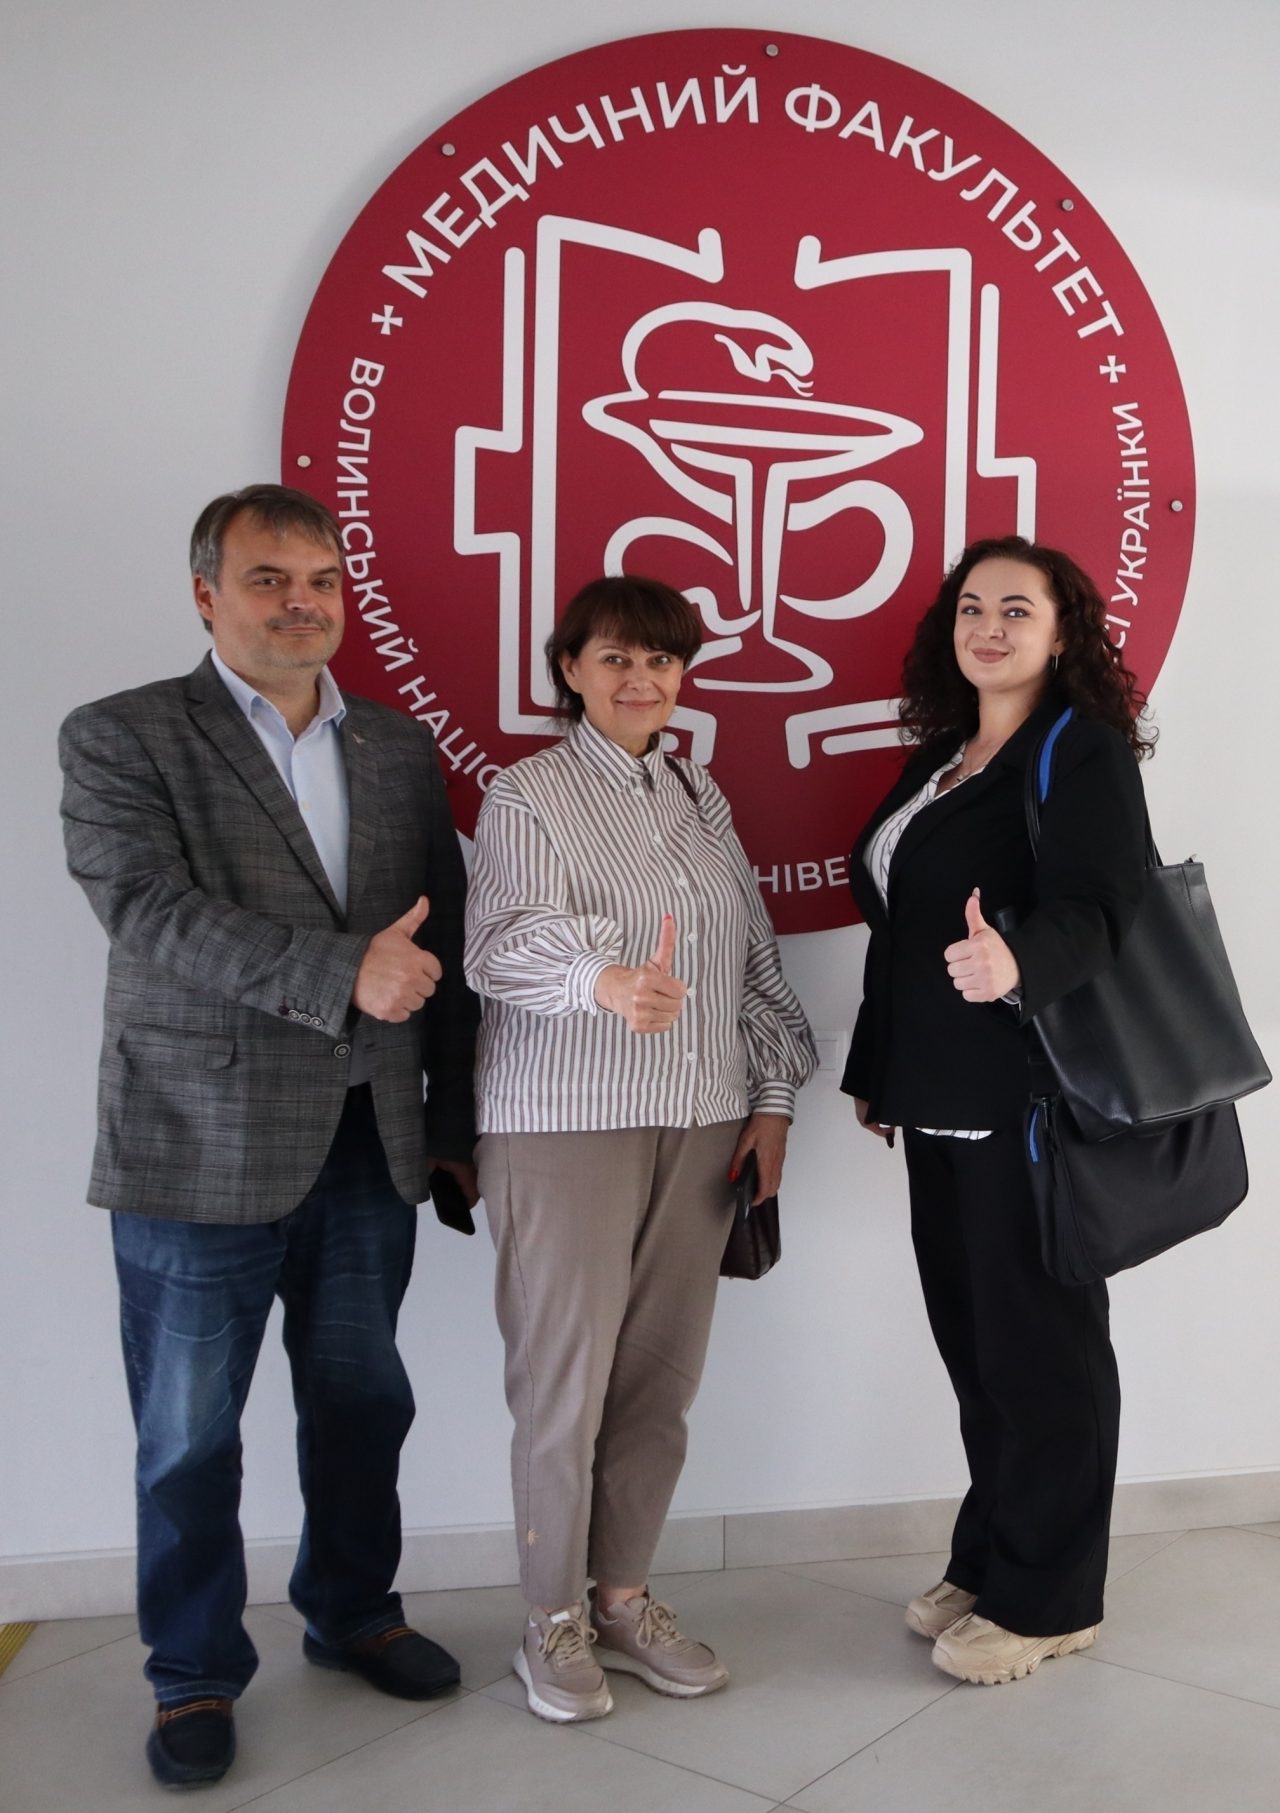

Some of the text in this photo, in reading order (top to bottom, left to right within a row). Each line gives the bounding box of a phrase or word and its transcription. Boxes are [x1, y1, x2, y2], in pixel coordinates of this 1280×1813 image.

[381, 64, 1125, 339] МЕДИЧНИЙ ФАКУЛЬТЕТ
[336, 356, 419, 672] ВОЛИНСЬКИЙ
[1111, 402, 1151, 607] УКРАЇНКИ
